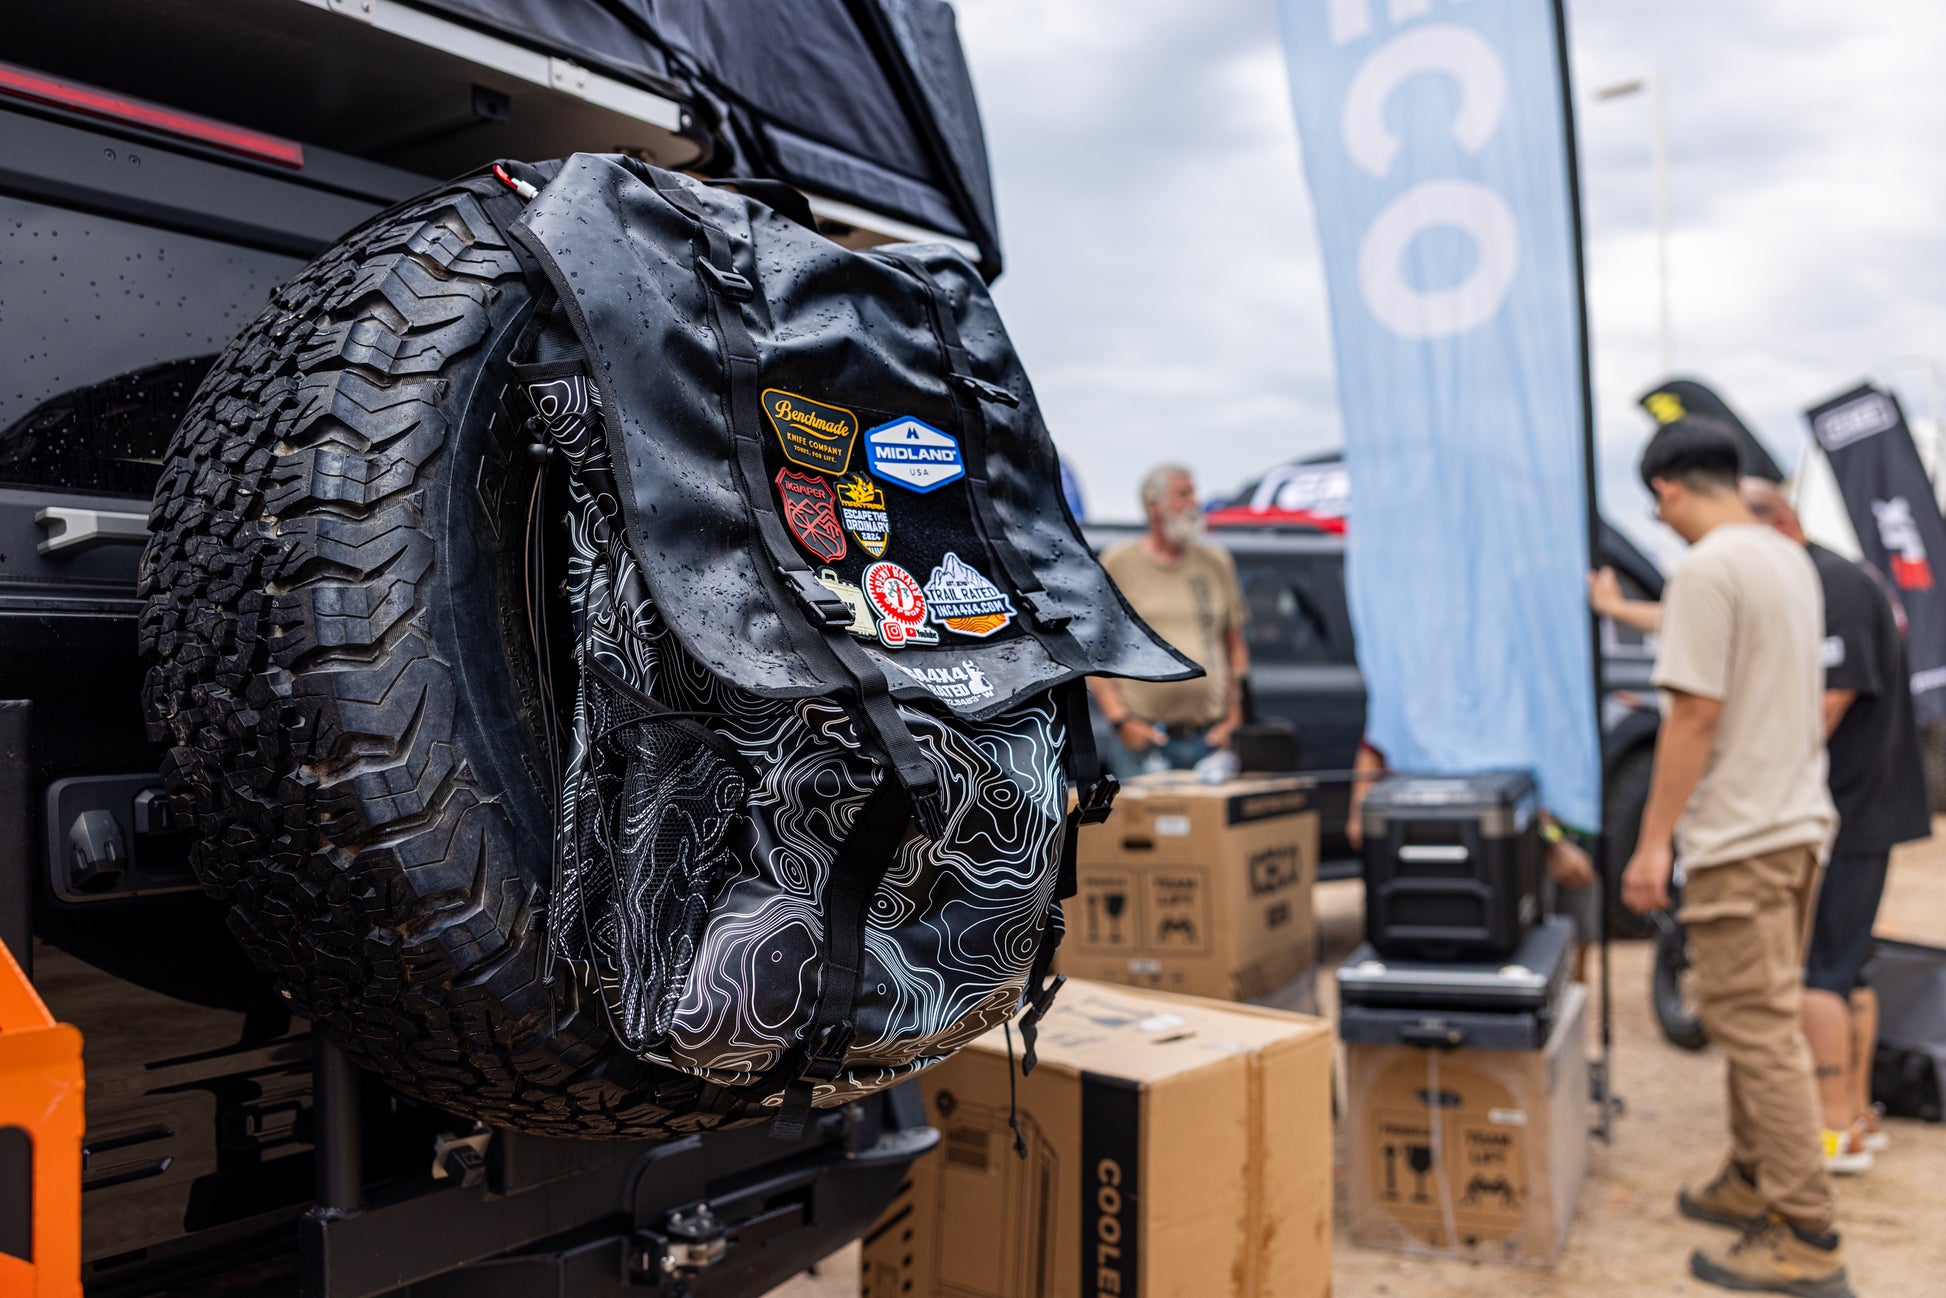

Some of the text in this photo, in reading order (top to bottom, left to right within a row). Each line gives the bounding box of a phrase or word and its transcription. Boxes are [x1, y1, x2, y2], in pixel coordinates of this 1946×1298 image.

[774, 399, 850, 437] Benchmade
[786, 432, 842, 456] KNIFE COMPANY
[909, 468, 929, 477] USA
[842, 508, 889, 522] ESCAPE THE
[845, 519, 890, 533] ORDINARY
[861, 532, 882, 541] 2024
[875, 569, 891, 594] SPENT
[928, 586, 998, 602] TRAIL RATED
[935, 599, 1006, 618] INCA4X4.COM
[916, 628, 938, 639] YouTube
